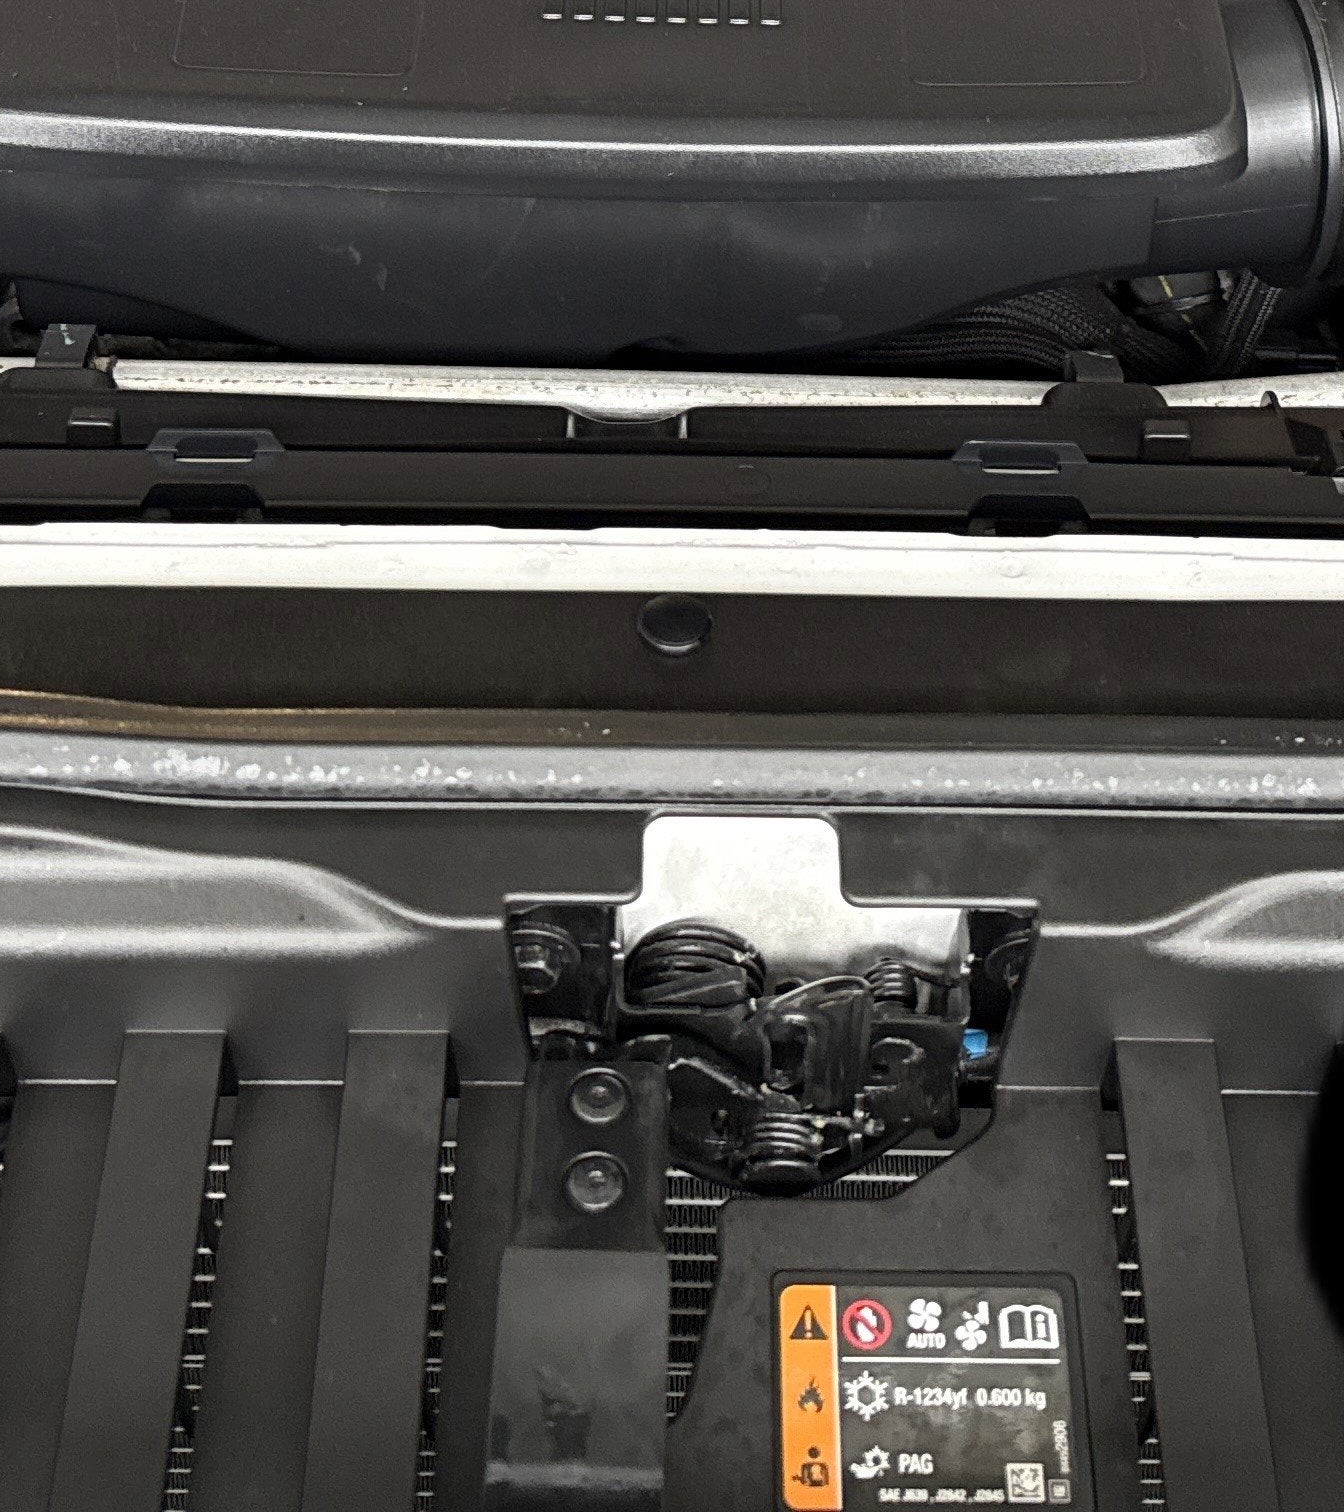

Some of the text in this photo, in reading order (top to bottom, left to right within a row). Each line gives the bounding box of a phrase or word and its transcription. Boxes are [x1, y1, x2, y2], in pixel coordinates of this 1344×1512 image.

[906, 1332, 946, 1349] AUTO
[893, 1386, 1047, 1411] R-1234yf 0.600 kg
[898, 1453, 934, 1474] PAG
